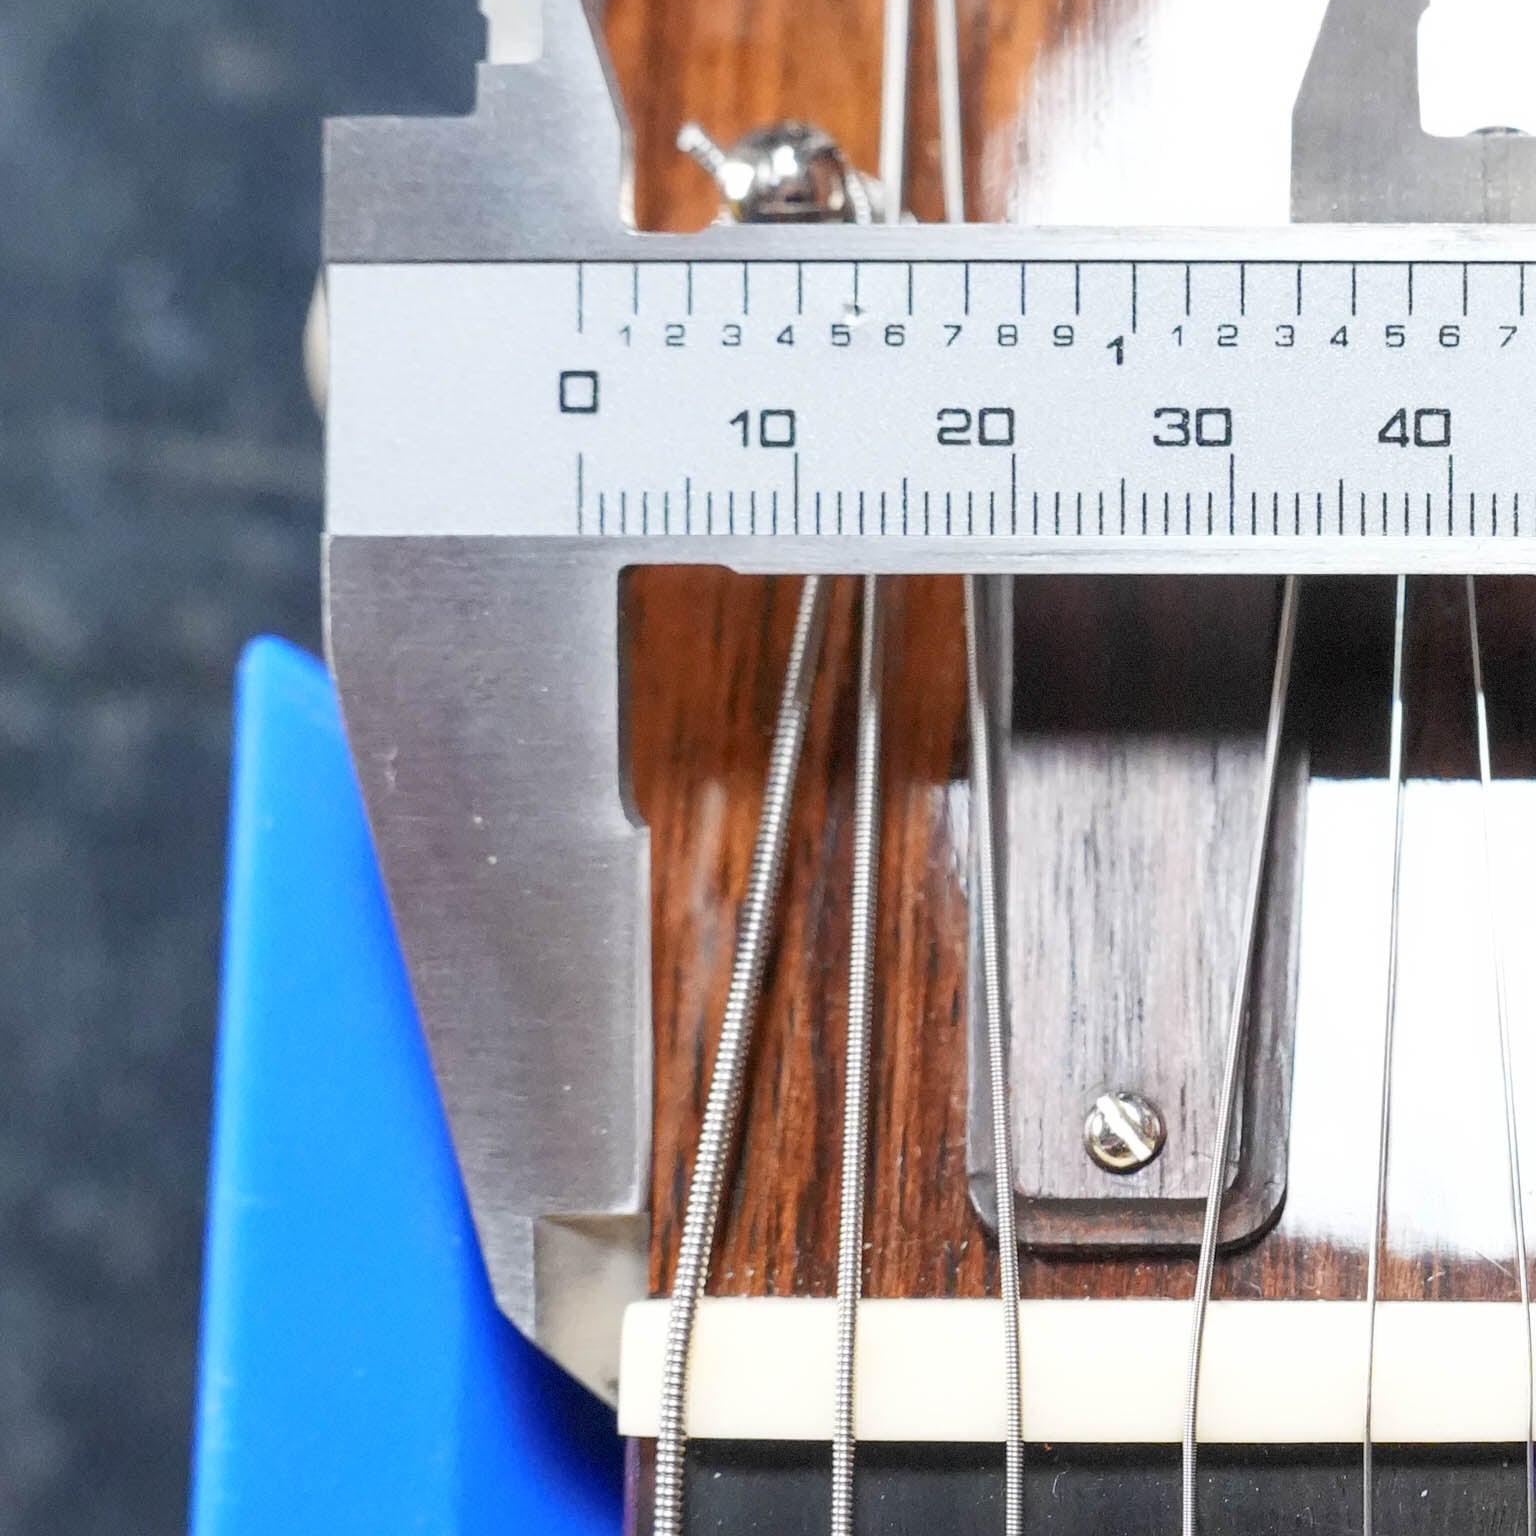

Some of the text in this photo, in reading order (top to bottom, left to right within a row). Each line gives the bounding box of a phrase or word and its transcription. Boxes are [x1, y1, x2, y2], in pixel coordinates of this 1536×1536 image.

[618, 323, 1518, 367] 1 2 3 4 5 6 7 8 9 1 1 2 3 4 5 6 7
[728, 406, 1453, 449] 10 20 30 40
